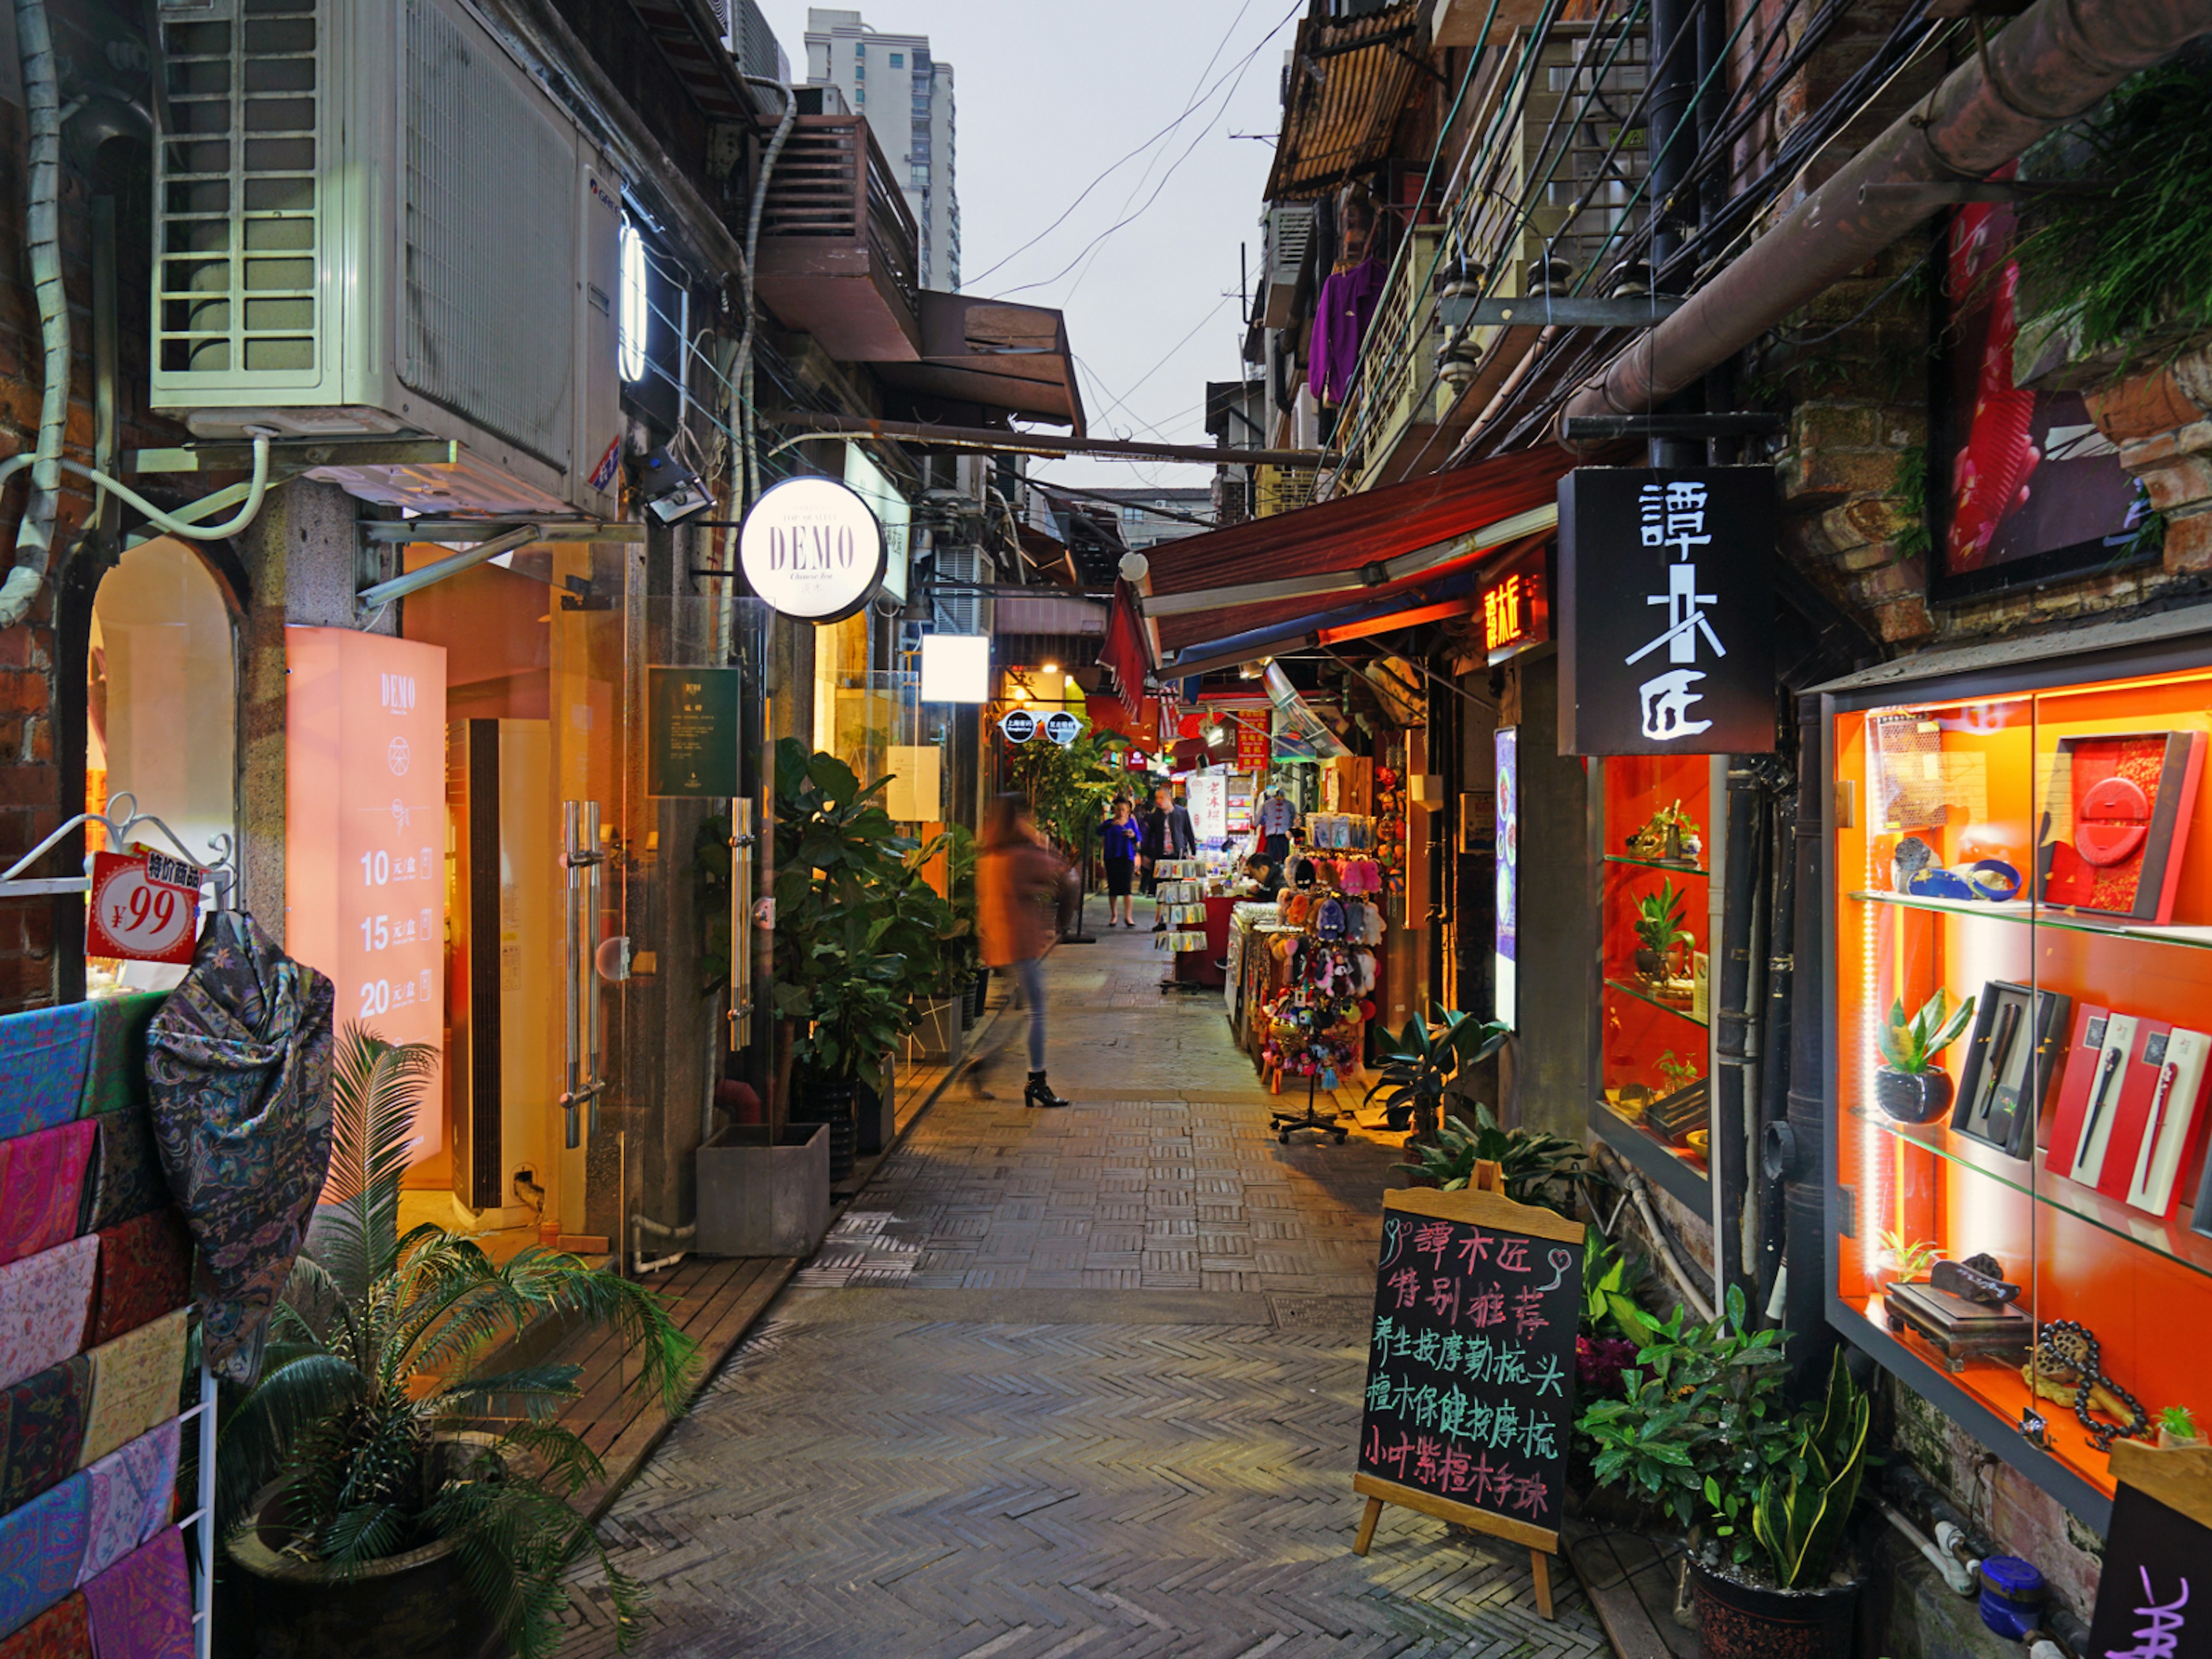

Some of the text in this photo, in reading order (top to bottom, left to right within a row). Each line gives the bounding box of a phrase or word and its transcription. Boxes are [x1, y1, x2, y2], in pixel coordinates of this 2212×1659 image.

[599, 190, 621, 218] GREE
[770, 524, 854, 571] DEMO
[1624, 482, 1727, 741] 譚木匠
[381, 672, 415, 710] DEMO
[149, 852, 200, 889] 特价商品
[360, 850, 416, 886] 10 元/盒
[112, 886, 175, 935] ¥99
[360, 914, 416, 952] 15 元/盒
[359, 979, 415, 1018] 20 元/盒
[1413, 1221, 1532, 1275] 譚木匠
[1387, 1267, 1550, 1340] 特别推荐
[1373, 1316, 1565, 1397] 养生按摩勤梳头
[1366, 1371, 1558, 1460] 檀木保健按摩梳
[1365, 1425, 1548, 1519] 小叶紫檀木手珠
